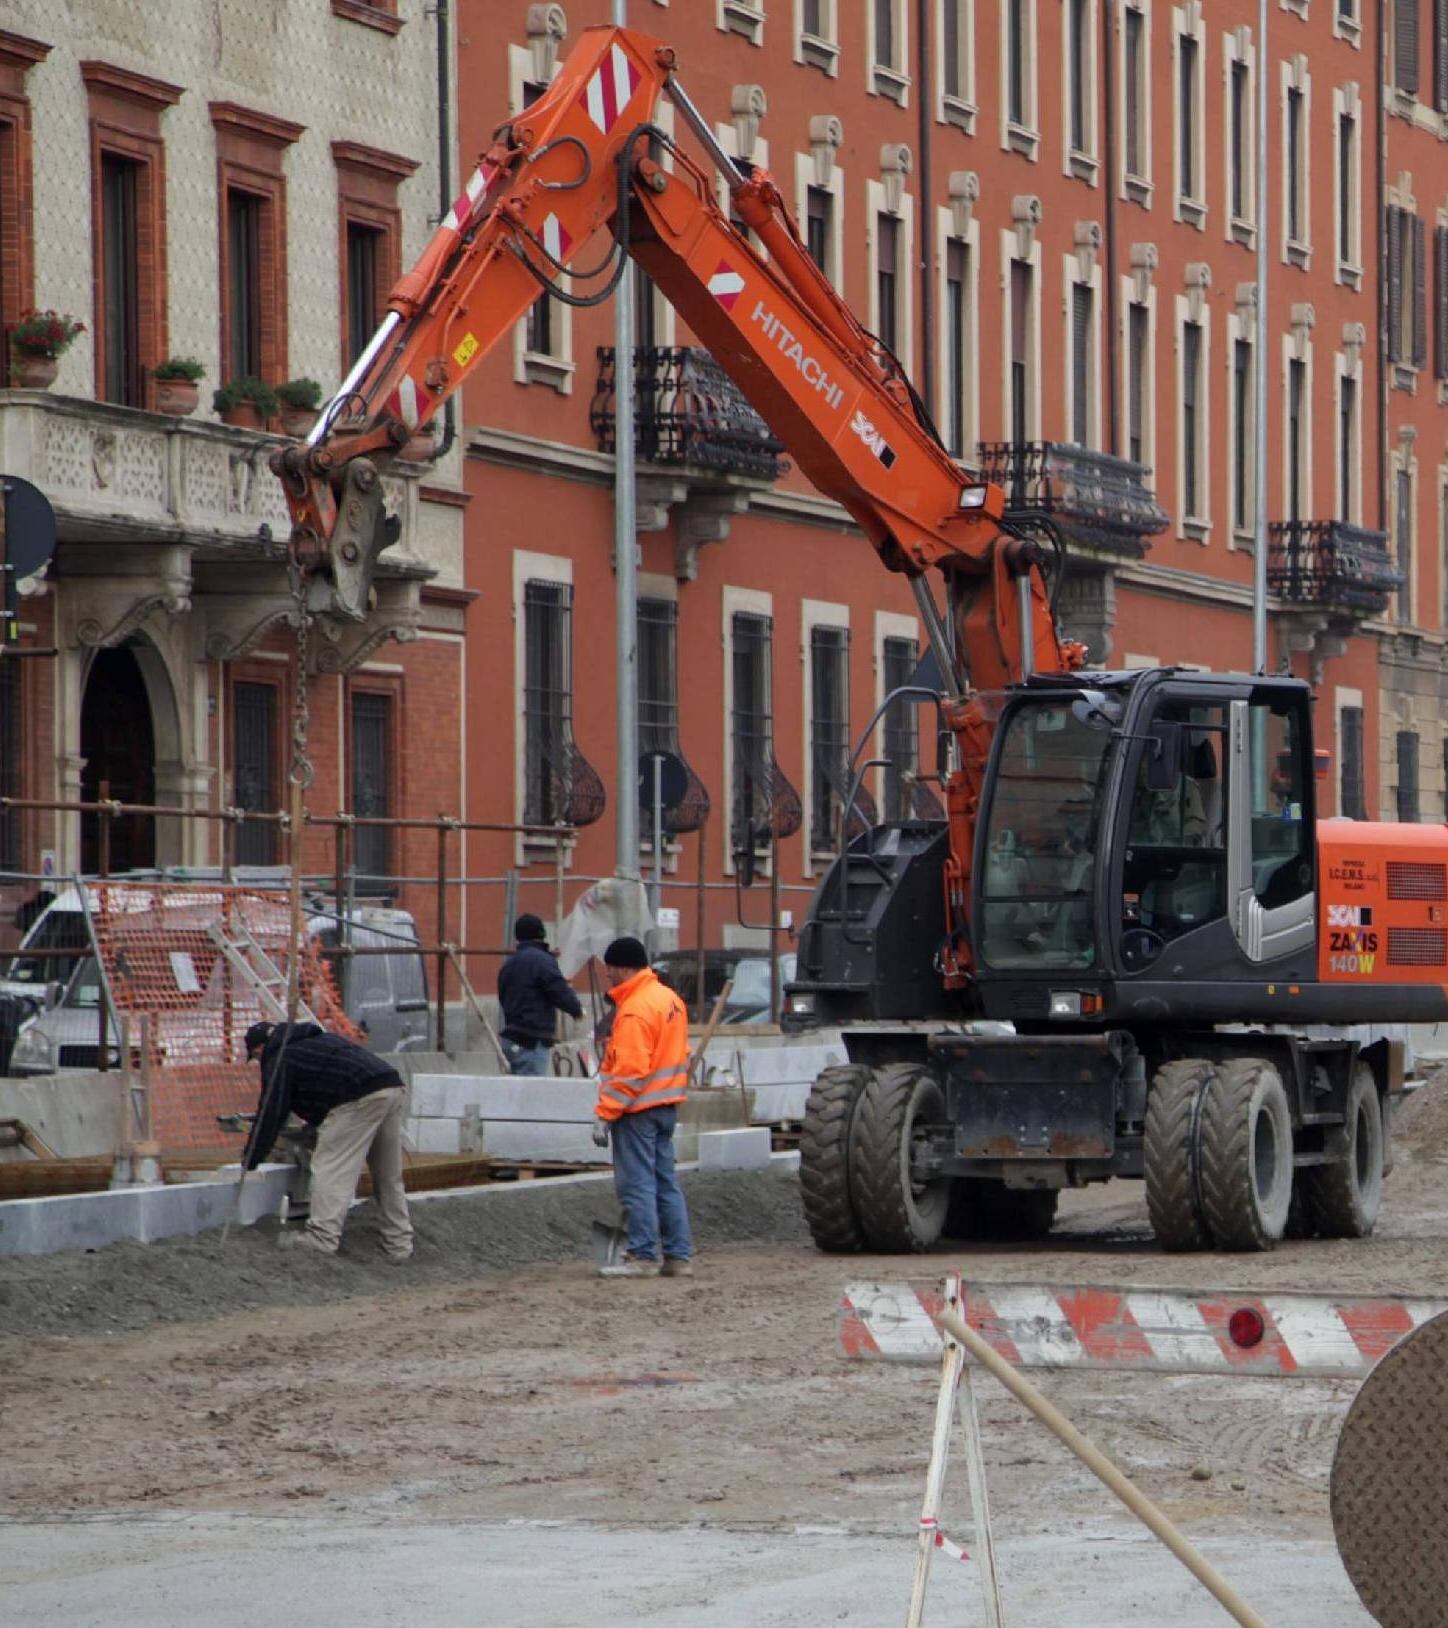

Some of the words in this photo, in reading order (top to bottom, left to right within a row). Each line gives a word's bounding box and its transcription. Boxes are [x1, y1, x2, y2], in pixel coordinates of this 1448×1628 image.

[752, 301, 845, 410] HITACHI
[1330, 930, 1377, 952] ZAXIS
[1329, 954, 1375, 974] 140W
